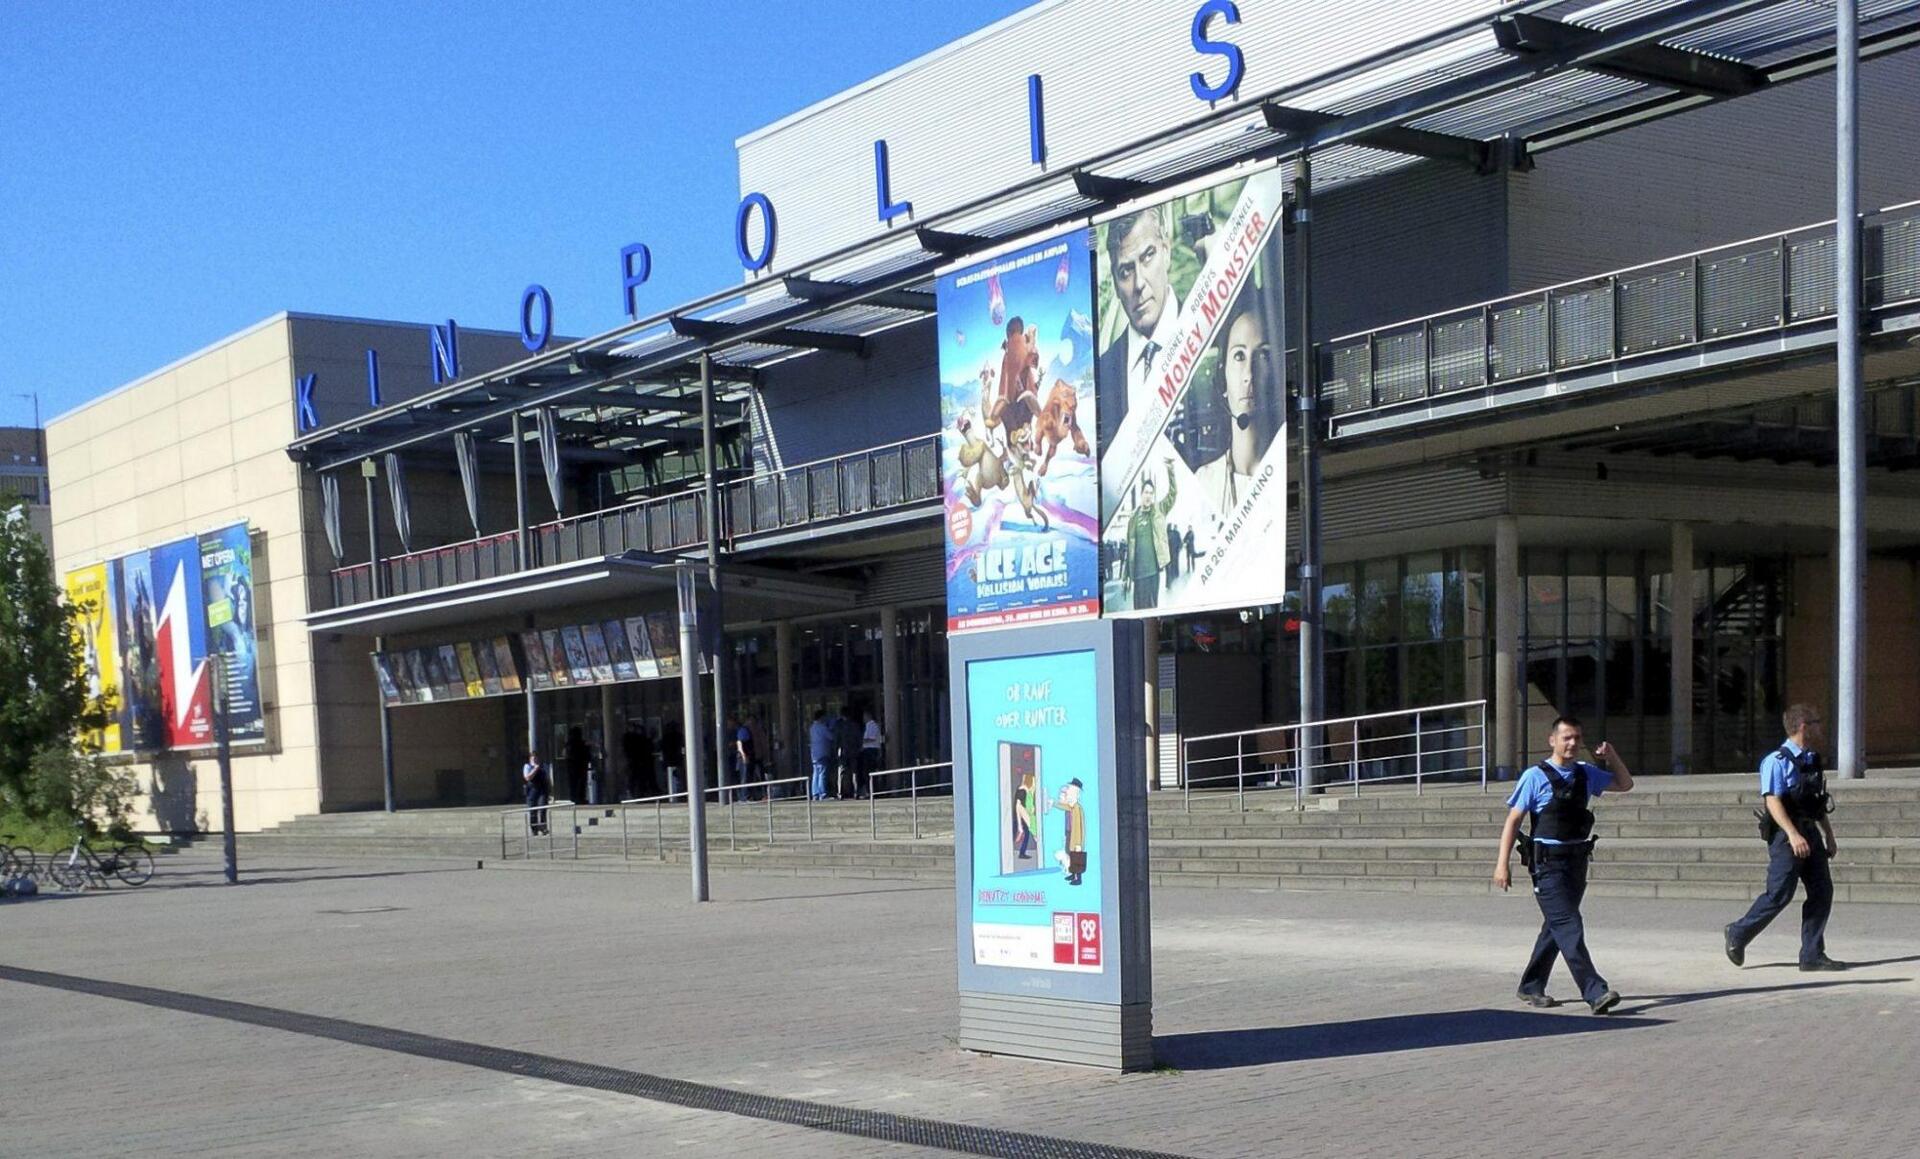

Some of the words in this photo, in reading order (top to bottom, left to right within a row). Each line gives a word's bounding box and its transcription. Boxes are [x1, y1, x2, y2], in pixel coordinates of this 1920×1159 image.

[1223, 196, 1255, 252] O'CONNELL
[1157, 321, 1203, 408] MONEY
[1200, 211, 1266, 327] MONSTER
[1190, 269, 1217, 314] ROBERTS
[1160, 327, 1185, 372] CLOONEY
[1224, 517, 1243, 545] MAI
[1240, 498, 1255, 520] IM
[1250, 464, 1274, 501] KINO
[975, 547, 1017, 583] ICE
[1019, 540, 1068, 577] AGE
[976, 579, 1025, 599] KOLLISION
[1006, 681, 1021, 702] OB
[1023, 678, 1054, 702] RAUF
[1023, 705, 1069, 729] RUNTER
